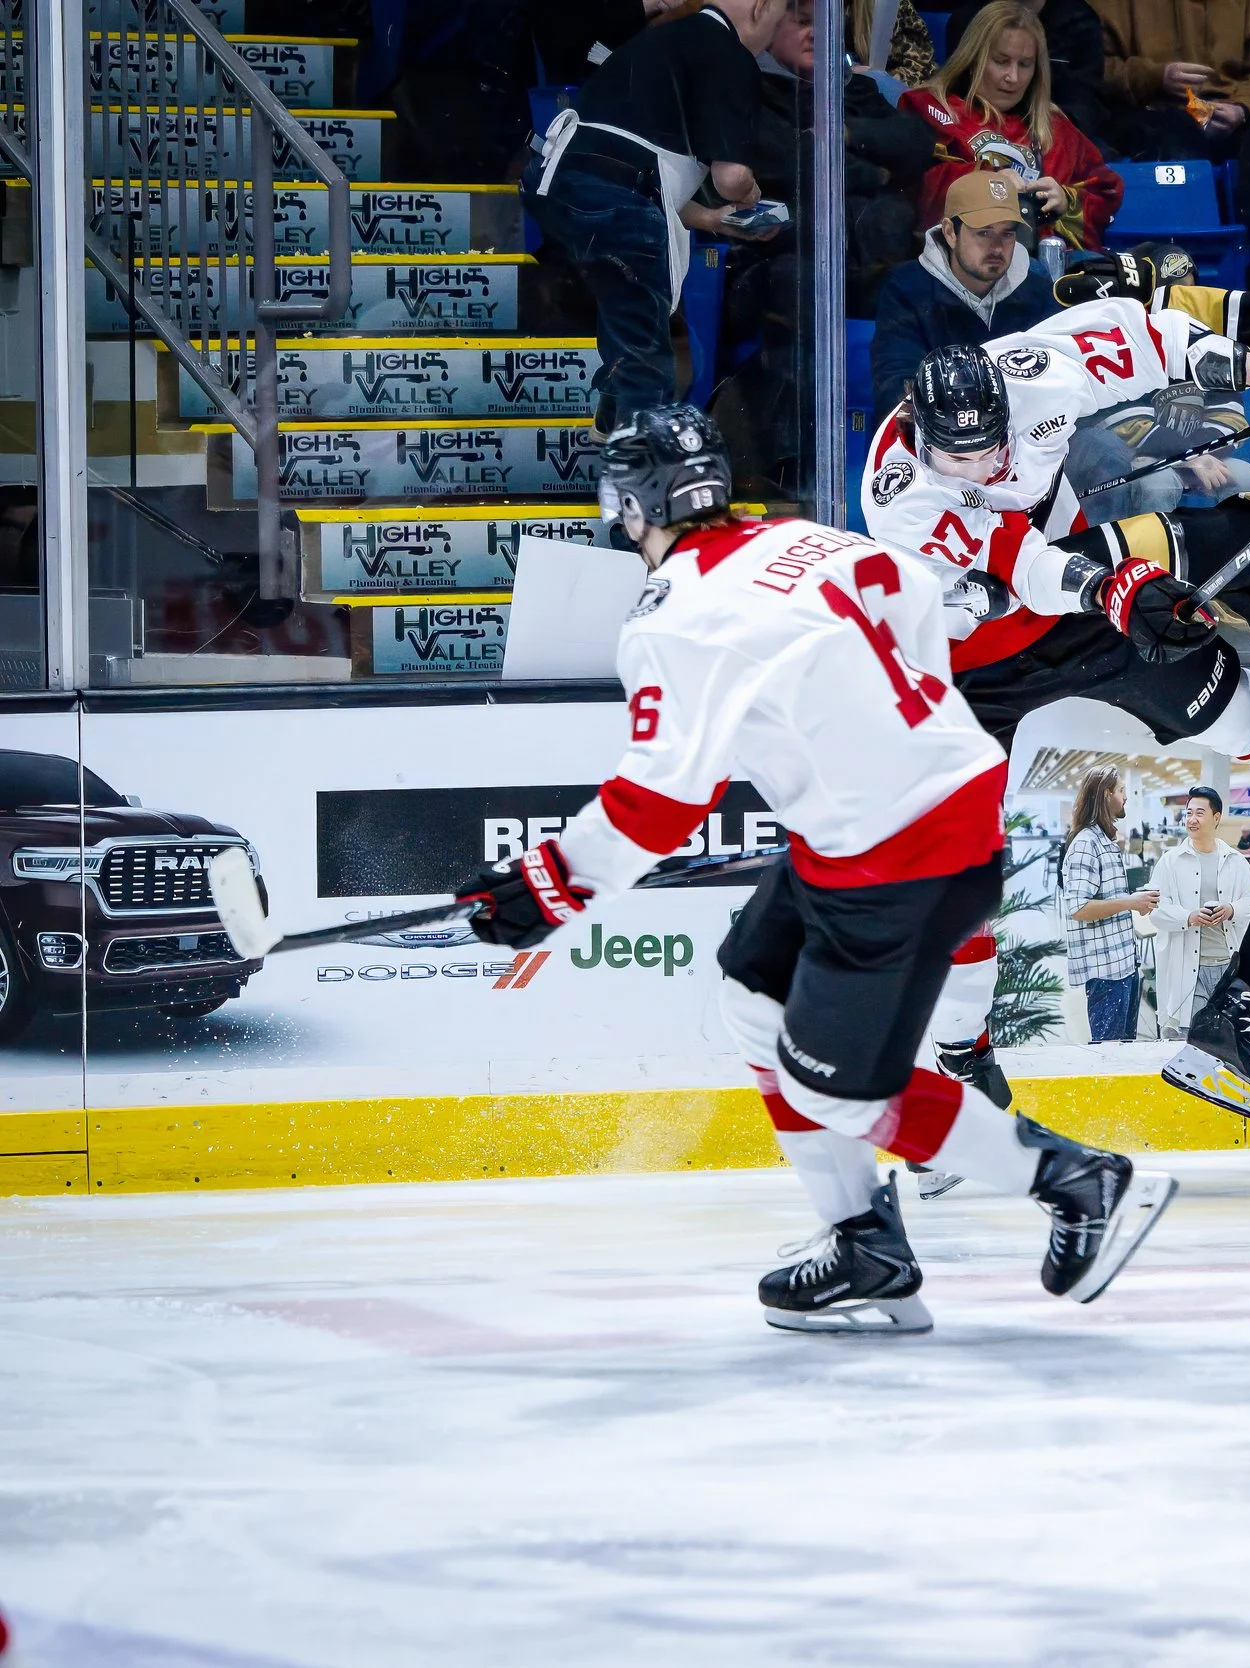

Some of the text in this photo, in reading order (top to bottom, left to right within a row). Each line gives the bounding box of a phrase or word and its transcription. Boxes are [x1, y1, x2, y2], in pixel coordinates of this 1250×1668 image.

[1166, 167, 1176, 184] 3
[352, 213, 453, 244] VALLEY
[387, 267, 463, 299] HIGH
[398, 288, 499, 319] VALLEY
[343, 351, 420, 385] HIGH
[482, 350, 558, 383] HIGH
[1072, 326, 1135, 386] 27
[355, 373, 459, 405] VALLEY
[494, 372, 594, 403] VALLEY
[925, 362, 935, 404] beneva
[983, 356, 1000, 396] beneva
[957, 409, 980, 428] 27
[1029, 414, 1068, 441] HEINZ
[397, 431, 477, 464] HIGH
[409, 452, 514, 484] VALLEY
[342, 523, 421, 559] HIGH
[487, 521, 565, 556] HIGH
[919, 509, 984, 568] 27
[355, 546, 462, 579] VALLEY
[349, 577, 457, 588] Plumbing & Heating
[1108, 559, 1163, 632] BAUER
[394, 607, 474, 642] HIGH
[401, 660, 503, 672] Plumbing & Heatin
[1186, 650, 1229, 720] BAUER
[570, 923, 695, 977] Jeep
[317, 961, 517, 983] DODGE
